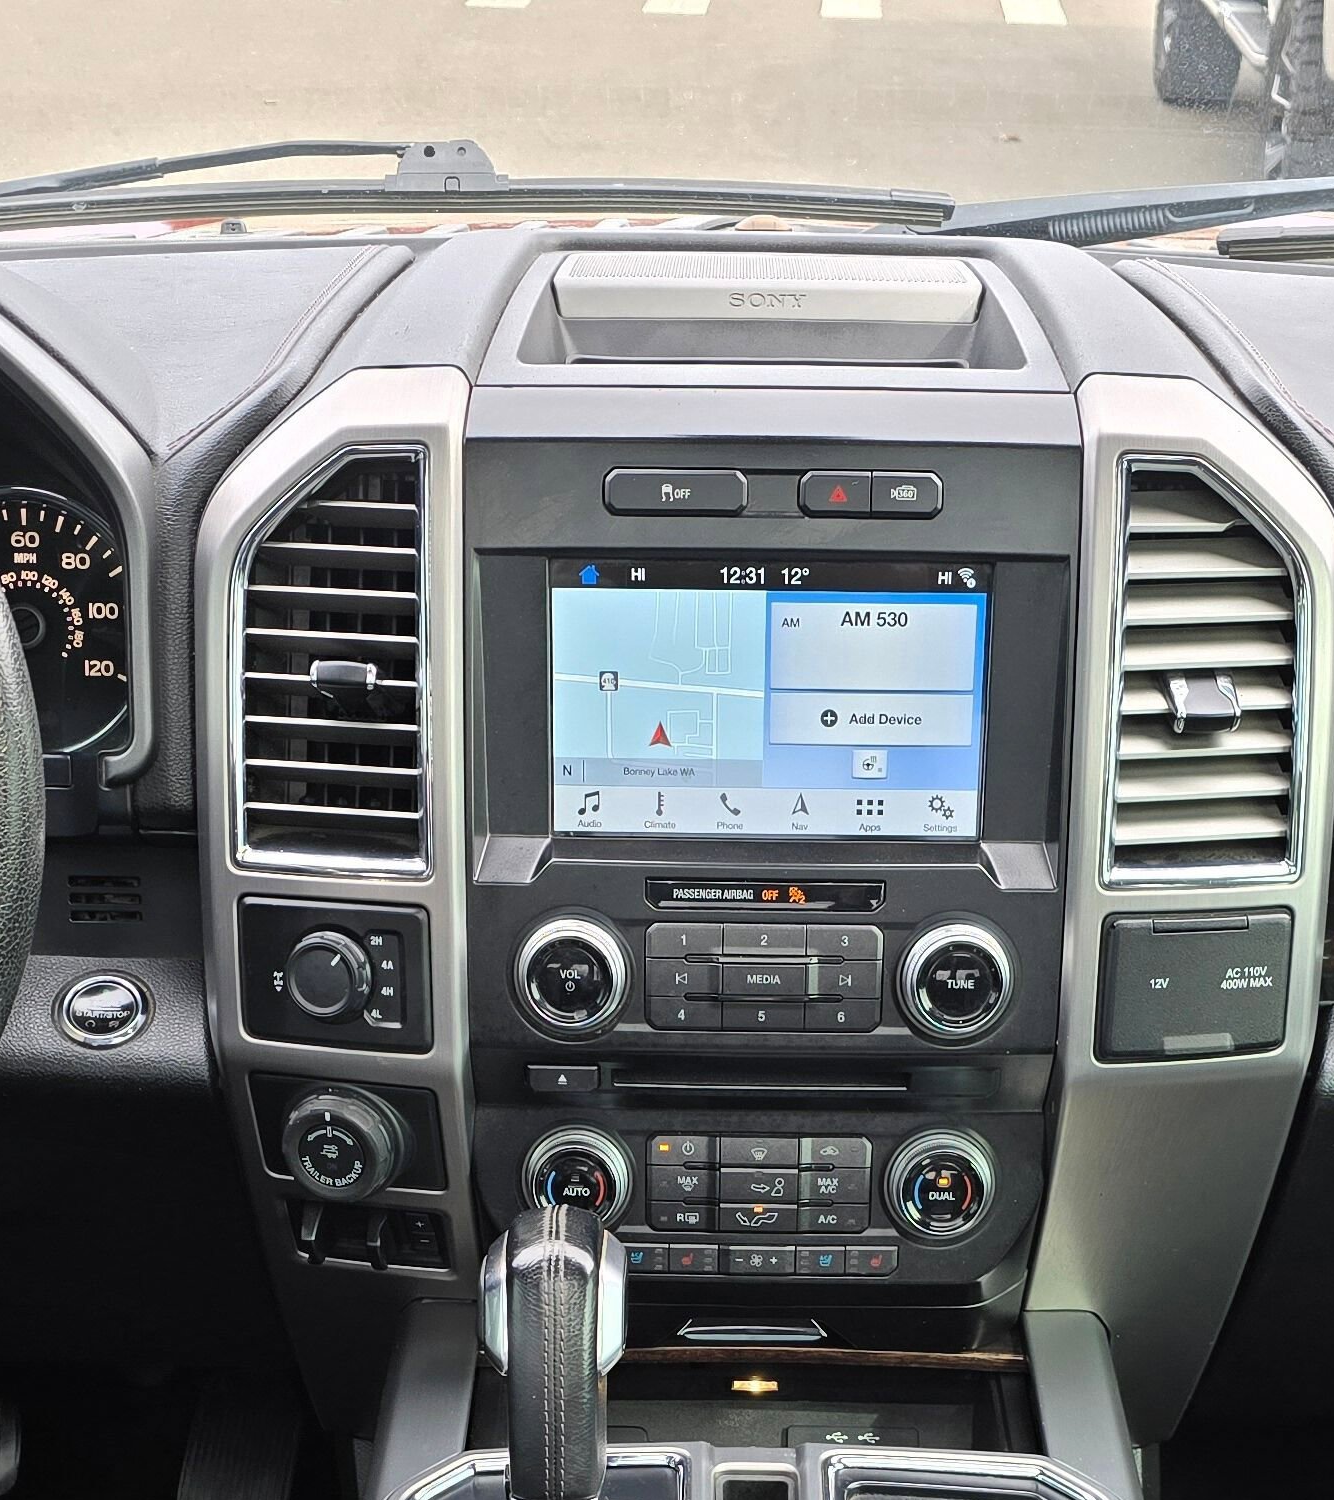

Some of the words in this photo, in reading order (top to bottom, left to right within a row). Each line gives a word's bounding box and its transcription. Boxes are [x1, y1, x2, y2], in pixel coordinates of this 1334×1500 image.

[729, 292, 806, 308] SONY
[674, 488, 691, 499] OFF
[10, 531, 40, 548] 60
[13, 553, 37, 564] MPH
[61, 552, 91, 570] 80
[1, 572, 17, 585] 80
[20, 570, 38, 581] 100
[630, 567, 646, 582] HI
[720, 566, 765, 584] 12:31
[781, 567, 810, 585] 12°
[937, 571, 952, 585] HI
[41, 574, 59, 590] 120
[59, 588, 75, 606] 140
[70, 607, 84, 626] 160
[88, 602, 119, 620] 100
[781, 617, 800, 628] AM
[840, 611, 871, 627] AM
[876, 611, 909, 628] 530
[73, 629, 85, 648] 180
[84, 659, 115, 677] 120
[849, 713, 875, 725] Add
[878, 713, 923, 726] Device
[562, 765, 572, 776] N
[623, 767, 655, 779] Bonney
[657, 767, 678, 777] Lake
[679, 768, 696, 777] WA
[577, 819, 602, 829] Audio
[644, 820, 676, 830] Climate
[716, 821, 744, 830] Phone
[791, 822, 809, 831] Nav
[858, 823, 882, 833] Apps
[923, 823, 958, 834] Settings
[673, 888, 722, 900] PASSENGER
[723, 889, 754, 900] AIRBAG
[761, 889, 779, 901] OFF
[370, 935, 383, 946] 2H
[680, 934, 687, 946] 1
[760, 934, 768, 946] 2
[840, 935, 849, 947] 3
[381, 960, 394, 970] 4A
[559, 969, 581, 980] VOL
[1225, 967, 1242, 979] AC
[1243, 965, 1268, 978] 110V
[747, 974, 781, 985] MEDIA
[947, 979, 975, 990] TUNE
[1149, 978, 1170, 989] 12V
[1220, 978, 1249, 990] 400W
[1249, 976, 1273, 988] MAX
[381, 986, 394, 997] 4H
[75, 1009, 131, 1019] START/STOP
[370, 1008, 383, 1019] 4L
[677, 1009, 685, 1021] 4
[757, 1010, 766, 1022] 5
[837, 1011, 846, 1023] 6
[301, 1155, 334, 1186] TRAILER
[334, 1160, 364, 1187] BACKUP
[677, 1175, 699, 1185] MAX
[817, 1177, 839, 1186] MAX
[562, 1187, 591, 1197] AUTO
[819, 1185, 837, 1194] A/C
[928, 1191, 956, 1201] DUAL
[676, 1213, 685, 1222] R
[818, 1215, 837, 1225] A/C
